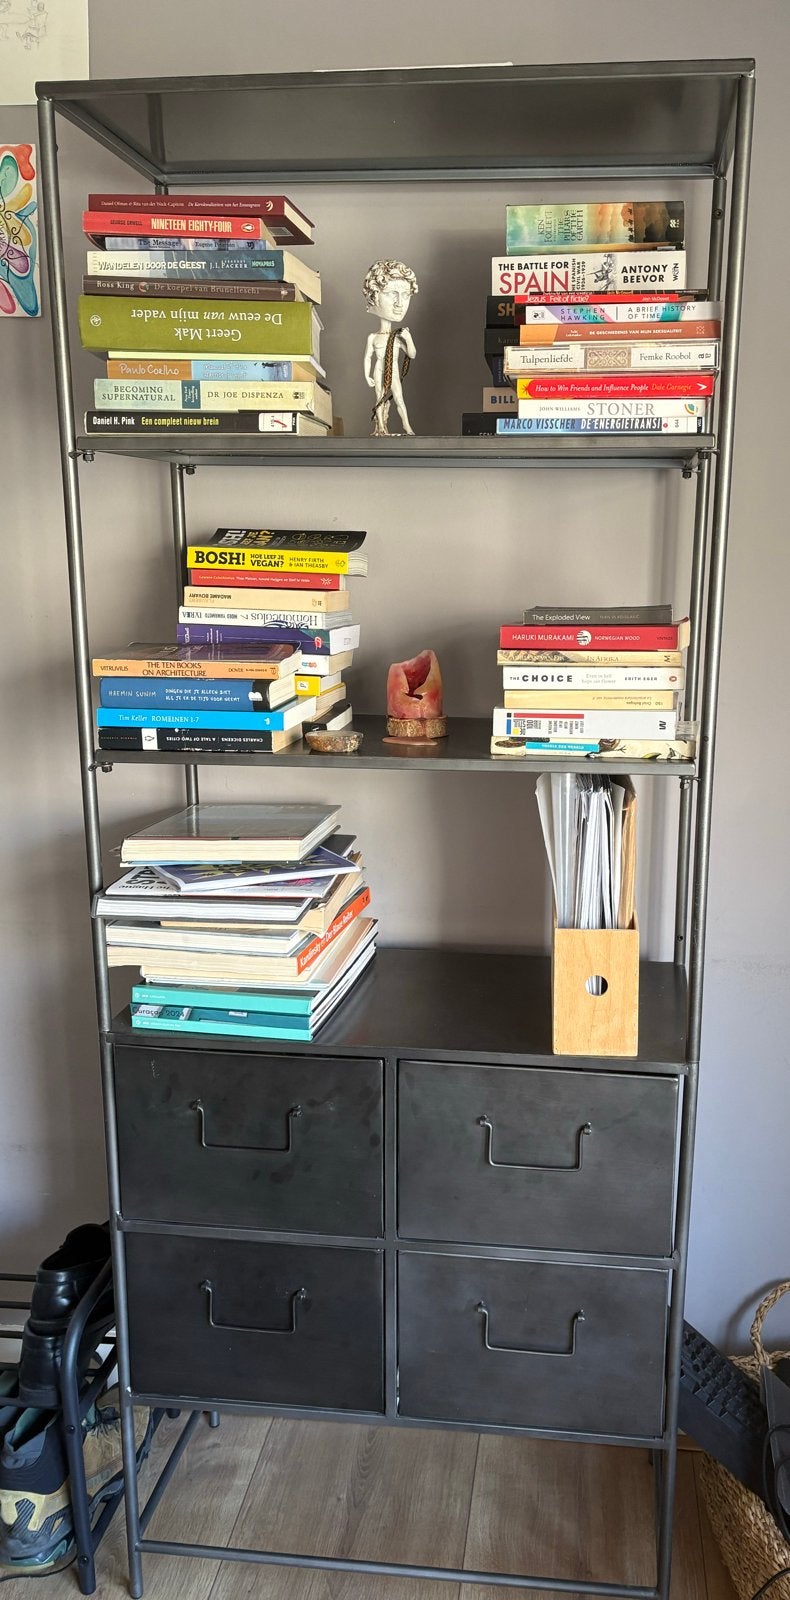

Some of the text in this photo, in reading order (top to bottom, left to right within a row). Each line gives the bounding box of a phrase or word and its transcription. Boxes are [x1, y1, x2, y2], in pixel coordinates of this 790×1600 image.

[151, 218, 232, 233] NINETEEN EIGHTY-FOUR
[544, 209, 552, 242] FOLLETT
[571, 231, 576, 241] OF
[153, 240, 180, 248] Message
[98, 261, 144, 270] WANDELEN
[145, 261, 167, 270] DOOR
[178, 260, 207, 269] GEEST
[517, 262, 549, 270] BATTLE
[551, 261, 569, 270] FOR
[621, 264, 668, 274] ANTONY
[499, 271, 569, 294] SPAIN
[623, 274, 665, 283] BEEVOR
[96, 280, 134, 291] Ross King
[167, 284, 193, 293] koepel
[210, 285, 260, 294] Brunelleschi
[526, 295, 546, 303] Jezus
[570, 295, 590, 303] fictie?
[131, 309, 282, 325] De eeuw van mijn vader
[561, 313, 605, 321] HAWKING
[174, 328, 242, 341] Geert Mak
[520, 355, 573, 365] Tulpenliefde
[639, 351, 691, 361] Femke Roobol
[119, 364, 179, 376] Paulo Coelho
[557, 384, 568, 392] Win
[570, 384, 590, 392] Friends
[591, 384, 602, 392] and
[603, 383, 628, 392] Influence
[630, 383, 649, 393] People
[667, 384, 691, 392] Carnegie
[102, 393, 176, 402] SUPERNATURAL
[491, 395, 516, 404] BILL
[587, 402, 655, 416] STONER
[93, 416, 135, 425] Daniel H. Pink
[141, 417, 219, 427] Een compleet nieuw brein
[503, 418, 575, 430] MARCO VISSCHER
[581, 418, 591, 430] DE
[194, 551, 245, 565] BOSH!
[250, 560, 284, 568] VEGAN?
[251, 612, 317, 626] Homunculus
[155, 669, 206, 677] ARCHITECTURE
[300, 942, 321, 967] Kandinsky
